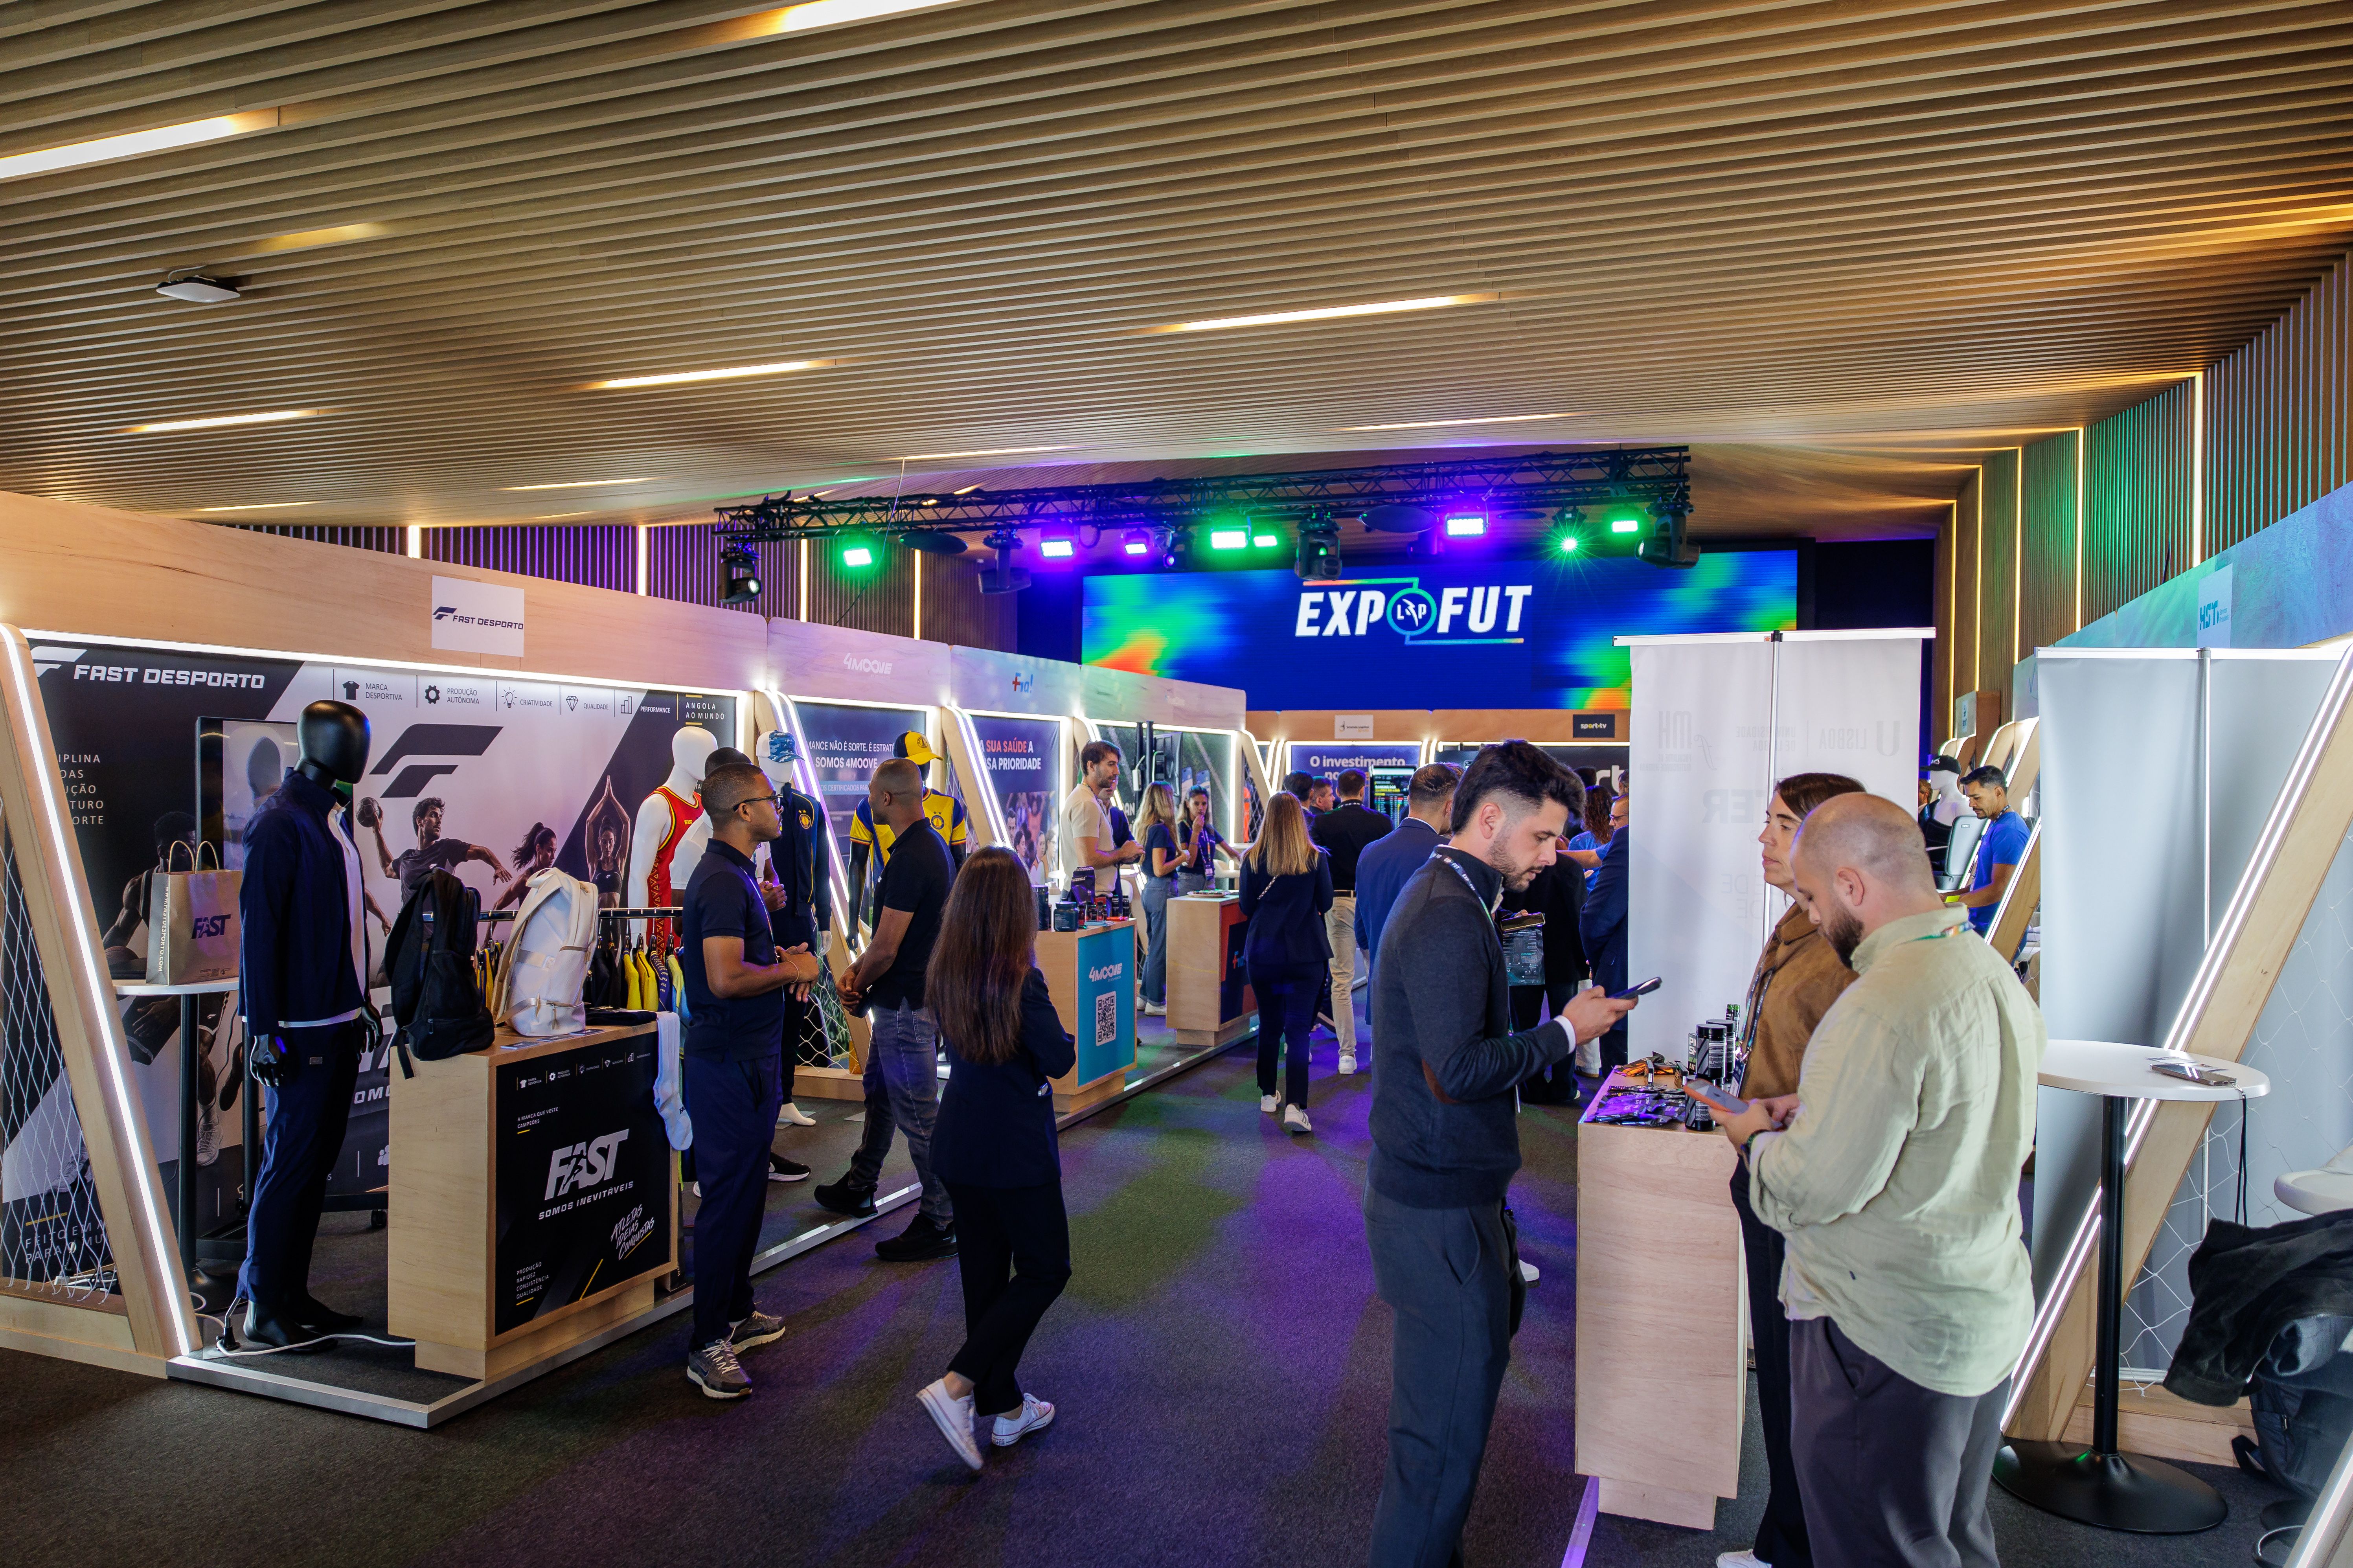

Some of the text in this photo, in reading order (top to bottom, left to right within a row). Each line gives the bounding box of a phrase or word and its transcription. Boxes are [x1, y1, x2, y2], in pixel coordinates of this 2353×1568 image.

[453, 615, 524, 630] FAST DESPORTO
[74, 665, 265, 689] FAST DESPORTO
[365, 692, 403, 700] DESPORTIVA
[447, 688, 477, 697] PRODUÇÃO
[808, 741, 828, 750] MANCE
[829, 740, 842, 751] NÃO
[844, 741, 847, 751] É
[848, 743, 868, 752] SORTE.
[869, 741, 872, 752] É
[986, 740, 1002, 753] SUA
[1003, 737, 1027, 753] SAÚDE
[1028, 741, 1034, 753] A
[59, 754, 100, 763] IPLINA
[815, 756, 878, 769] SOMOS 4MOOVE
[998, 757, 1041, 770] PRIORIDADE
[1310, 755, 1406, 767] O investimento
[60, 770, 83, 778] OAS
[70, 800, 103, 809] TURO
[72, 816, 104, 825] ORTE
[191, 914, 231, 939] FAST
[517, 1119, 540, 1129] CAMPEÕES
[544, 1129, 629, 1200] FAST
[539, 1181, 634, 1220] SOMOS INEVITÁVEIS
[610, 1204, 643, 1242] ATLETAS
[25, 1229, 66, 1249] FEITO
[616, 1219, 639, 1249] IDEIAS
[25, 1245, 62, 1264] PARA
[517, 1262, 542, 1275] PRODUÇÃO
[517, 1272, 536, 1283] RAPIDEZ
[517, 1275, 549, 1291] CONSISTÊNCIA
[517, 1285, 542, 1299] QUALIDADE
